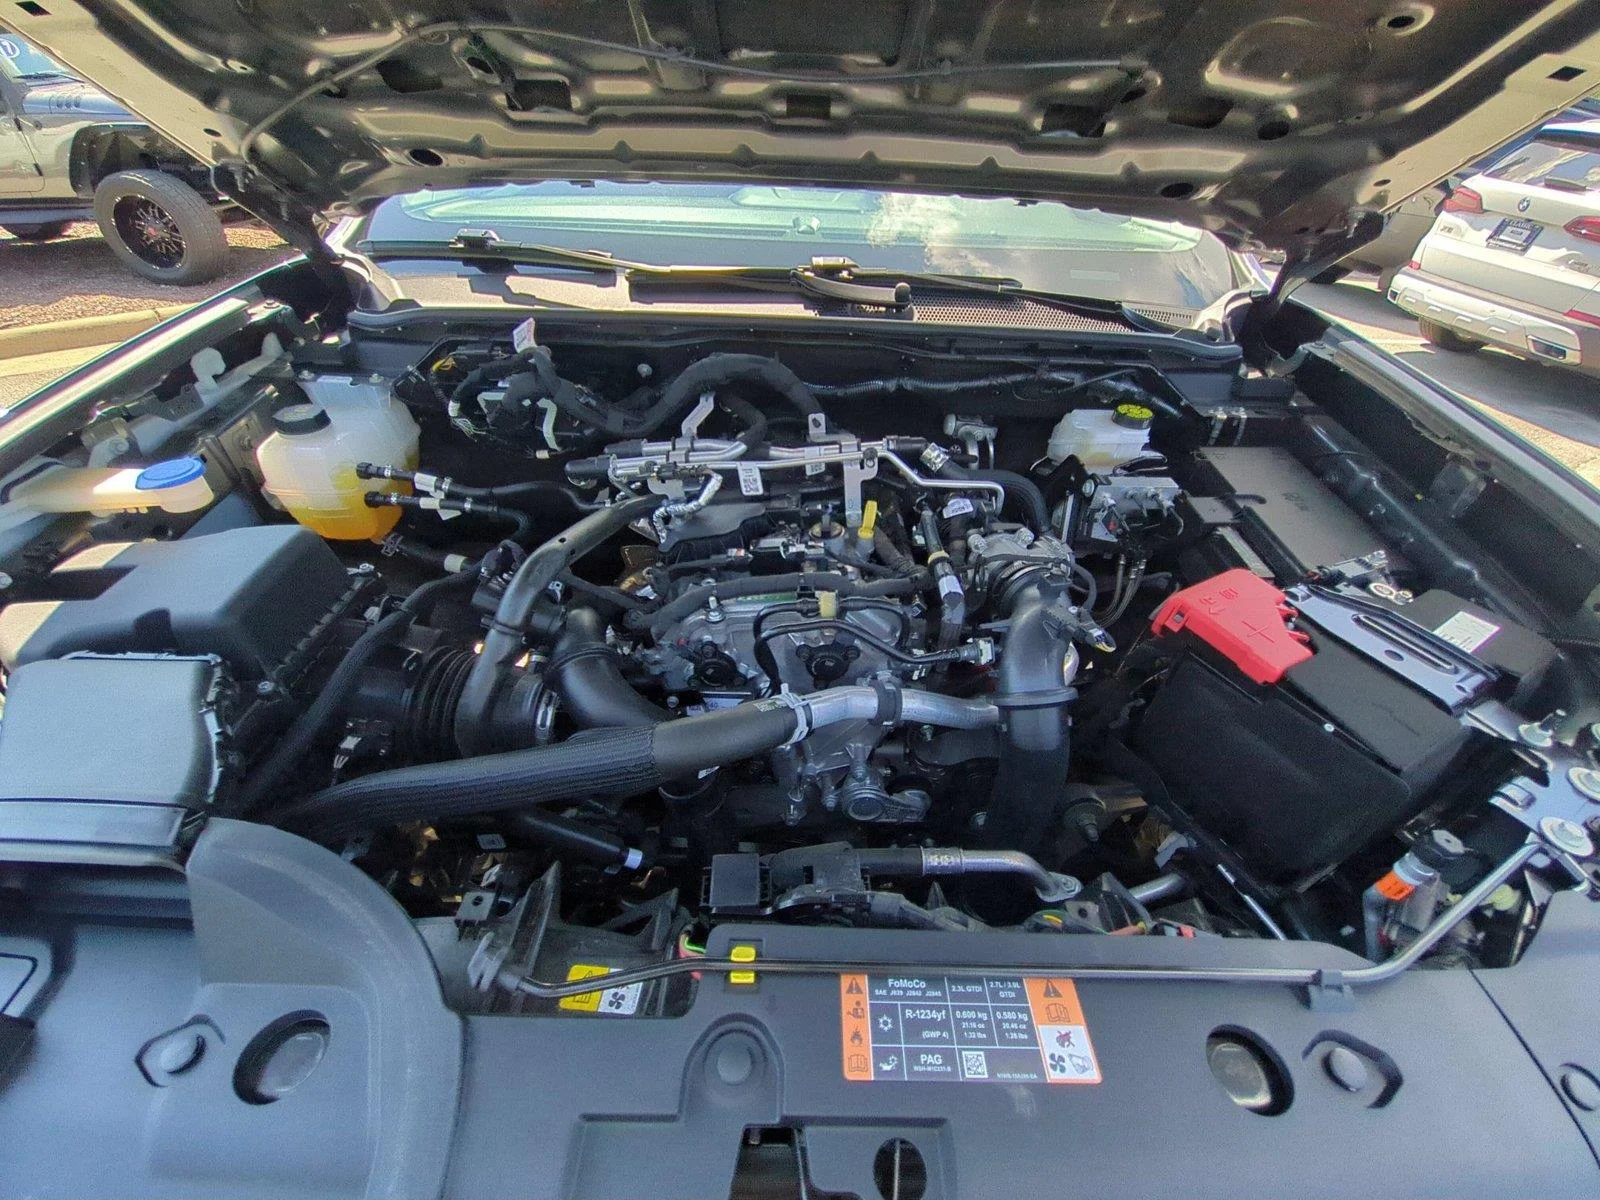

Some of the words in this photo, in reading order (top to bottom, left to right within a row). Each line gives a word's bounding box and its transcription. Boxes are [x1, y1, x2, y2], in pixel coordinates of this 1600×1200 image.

[888, 978, 926, 989] FoMoCo
[905, 1008, 946, 1021] R-1234yf
[955, 1010, 977, 1019] 0.600
[977, 1011, 988, 1021] kg
[996, 1011, 1017, 1020] 0.580
[1018, 1011, 1029, 1021] kg
[922, 1031, 941, 1039] (GWP
[942, 1031, 949, 1040] 4)
[920, 1054, 943, 1065] PAG
